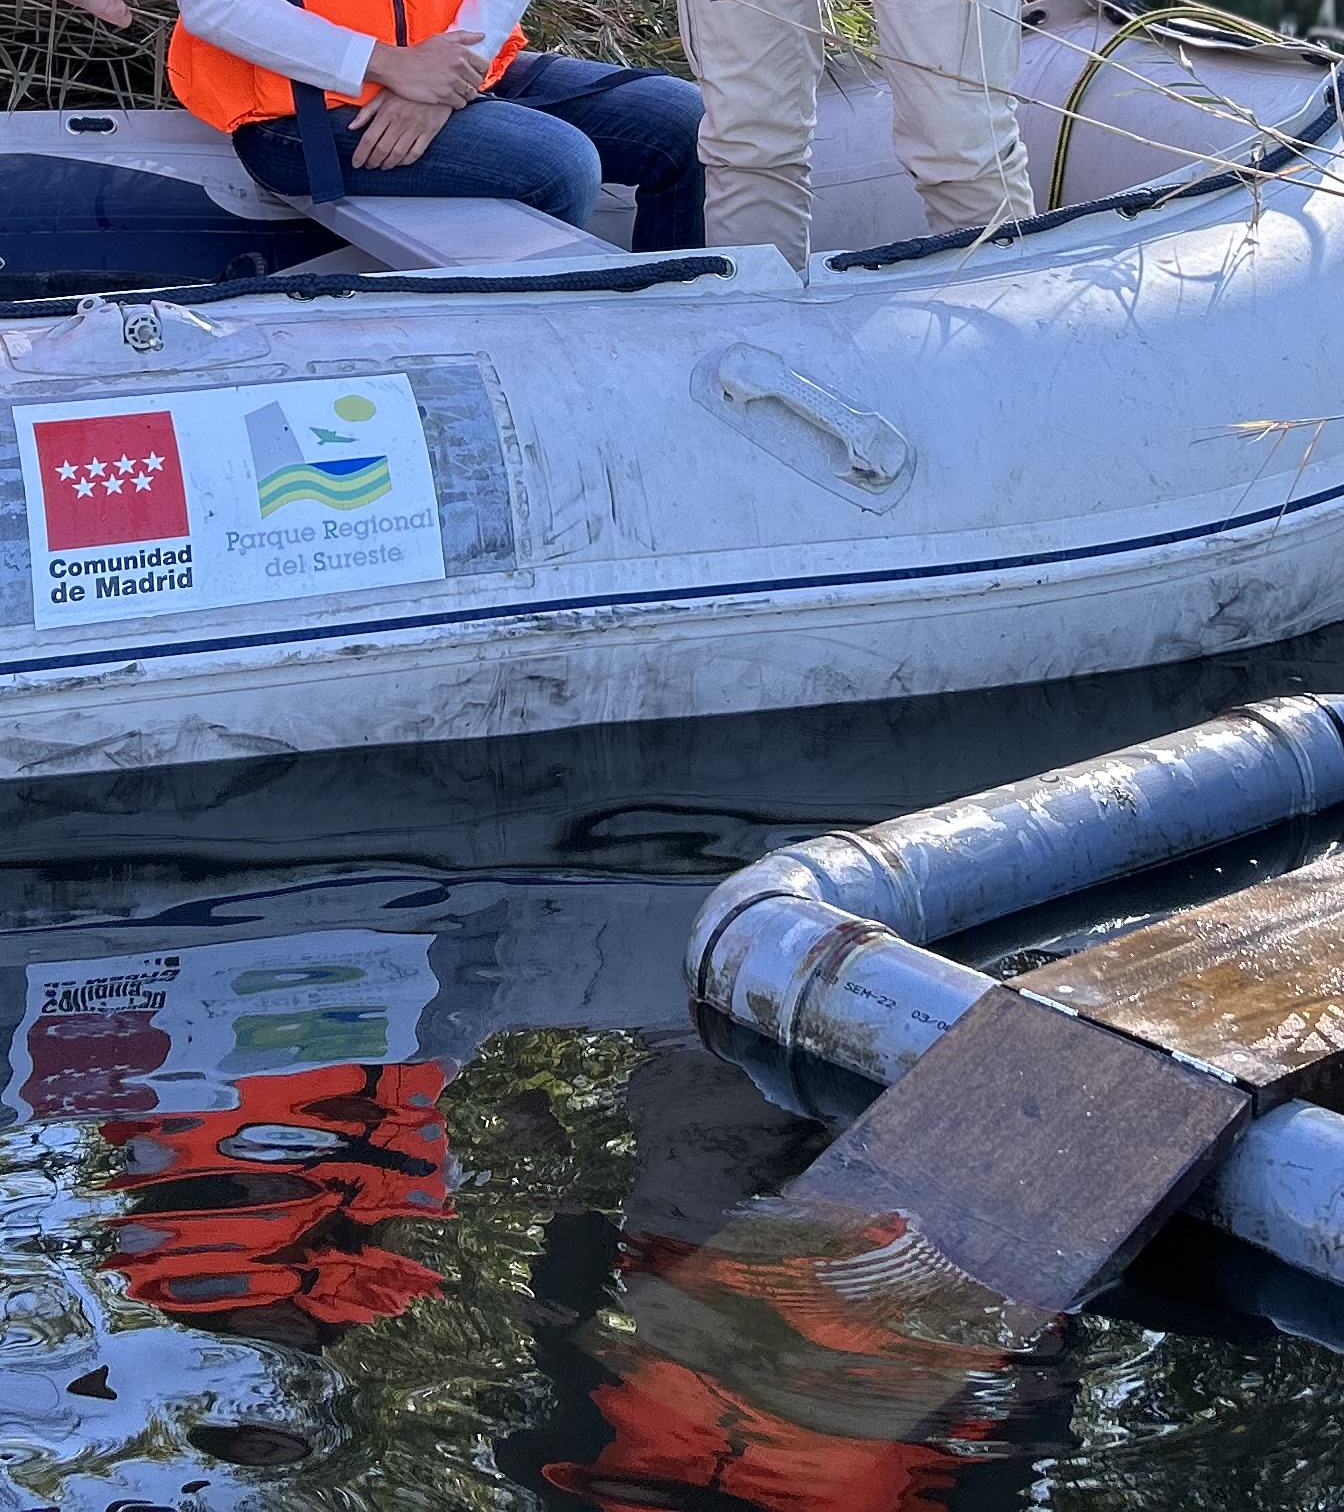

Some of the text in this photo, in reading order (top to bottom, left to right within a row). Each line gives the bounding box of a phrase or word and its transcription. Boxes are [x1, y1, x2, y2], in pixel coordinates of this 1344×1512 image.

[226, 508, 434, 552] Parque Regional
[49, 544, 193, 579] Comunidad
[265, 543, 404, 578] del Sureste
[50, 567, 193, 604] de Madrid
